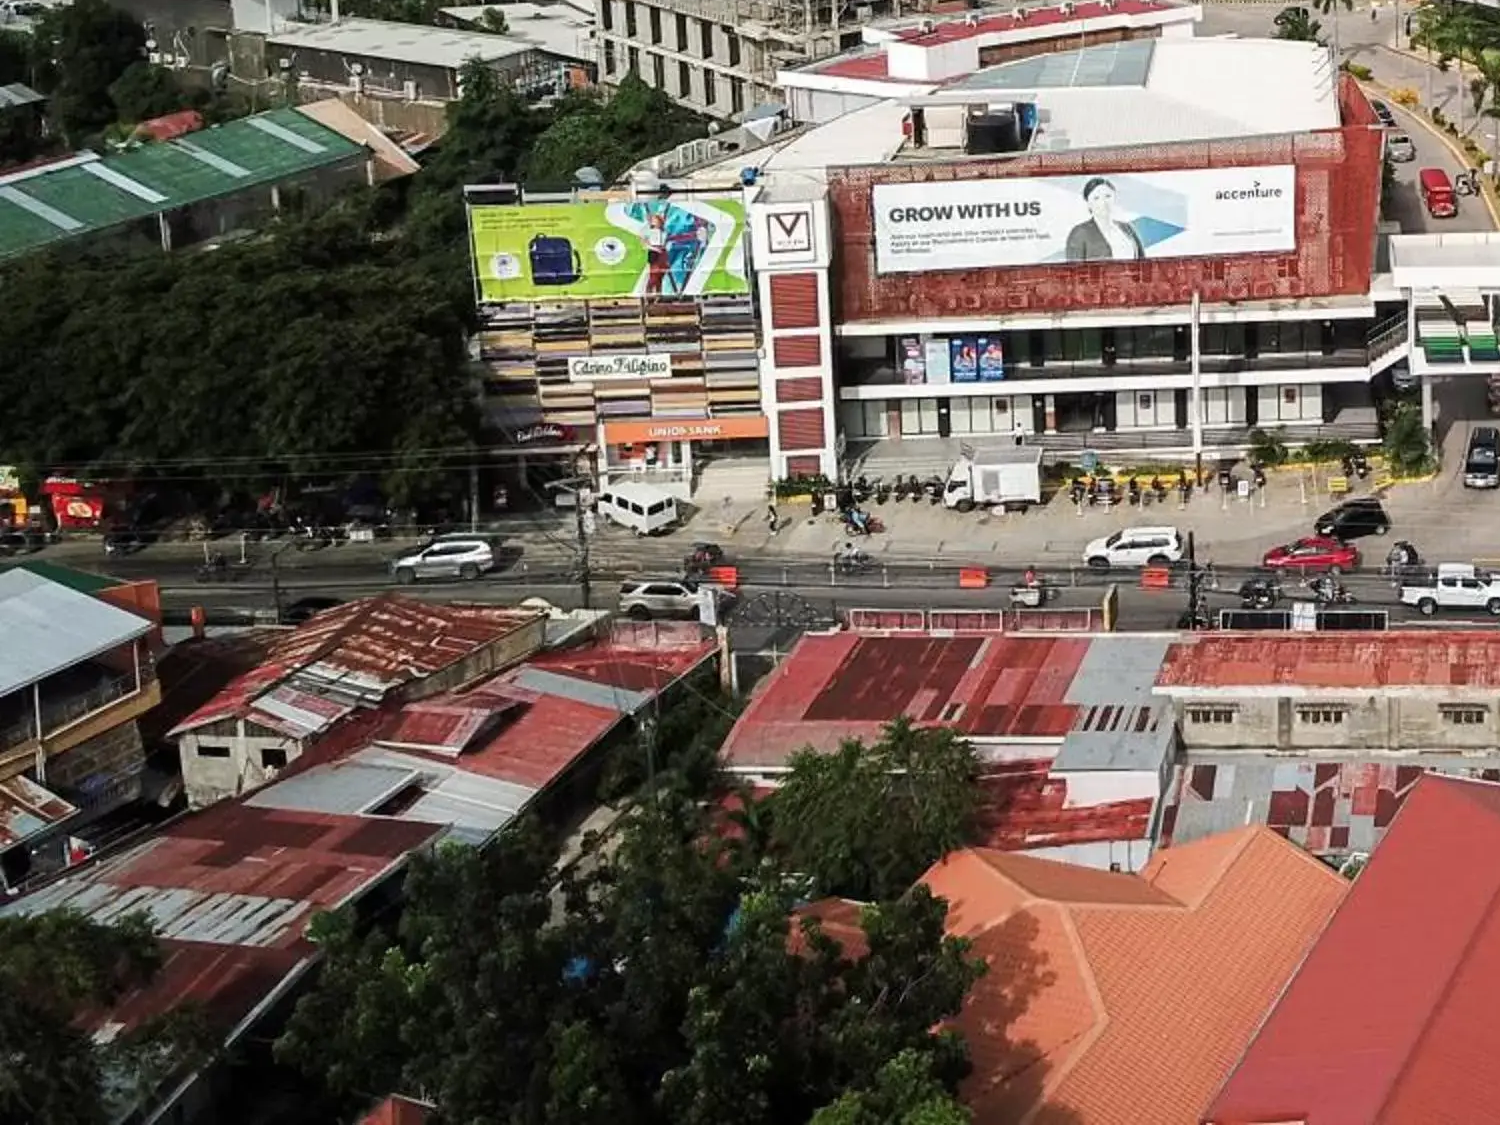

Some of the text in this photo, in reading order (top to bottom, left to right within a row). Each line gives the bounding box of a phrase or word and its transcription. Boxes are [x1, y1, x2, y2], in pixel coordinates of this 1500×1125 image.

[1216, 187, 1282, 200] accenture
[889, 201, 1041, 223] GROW WITH US
